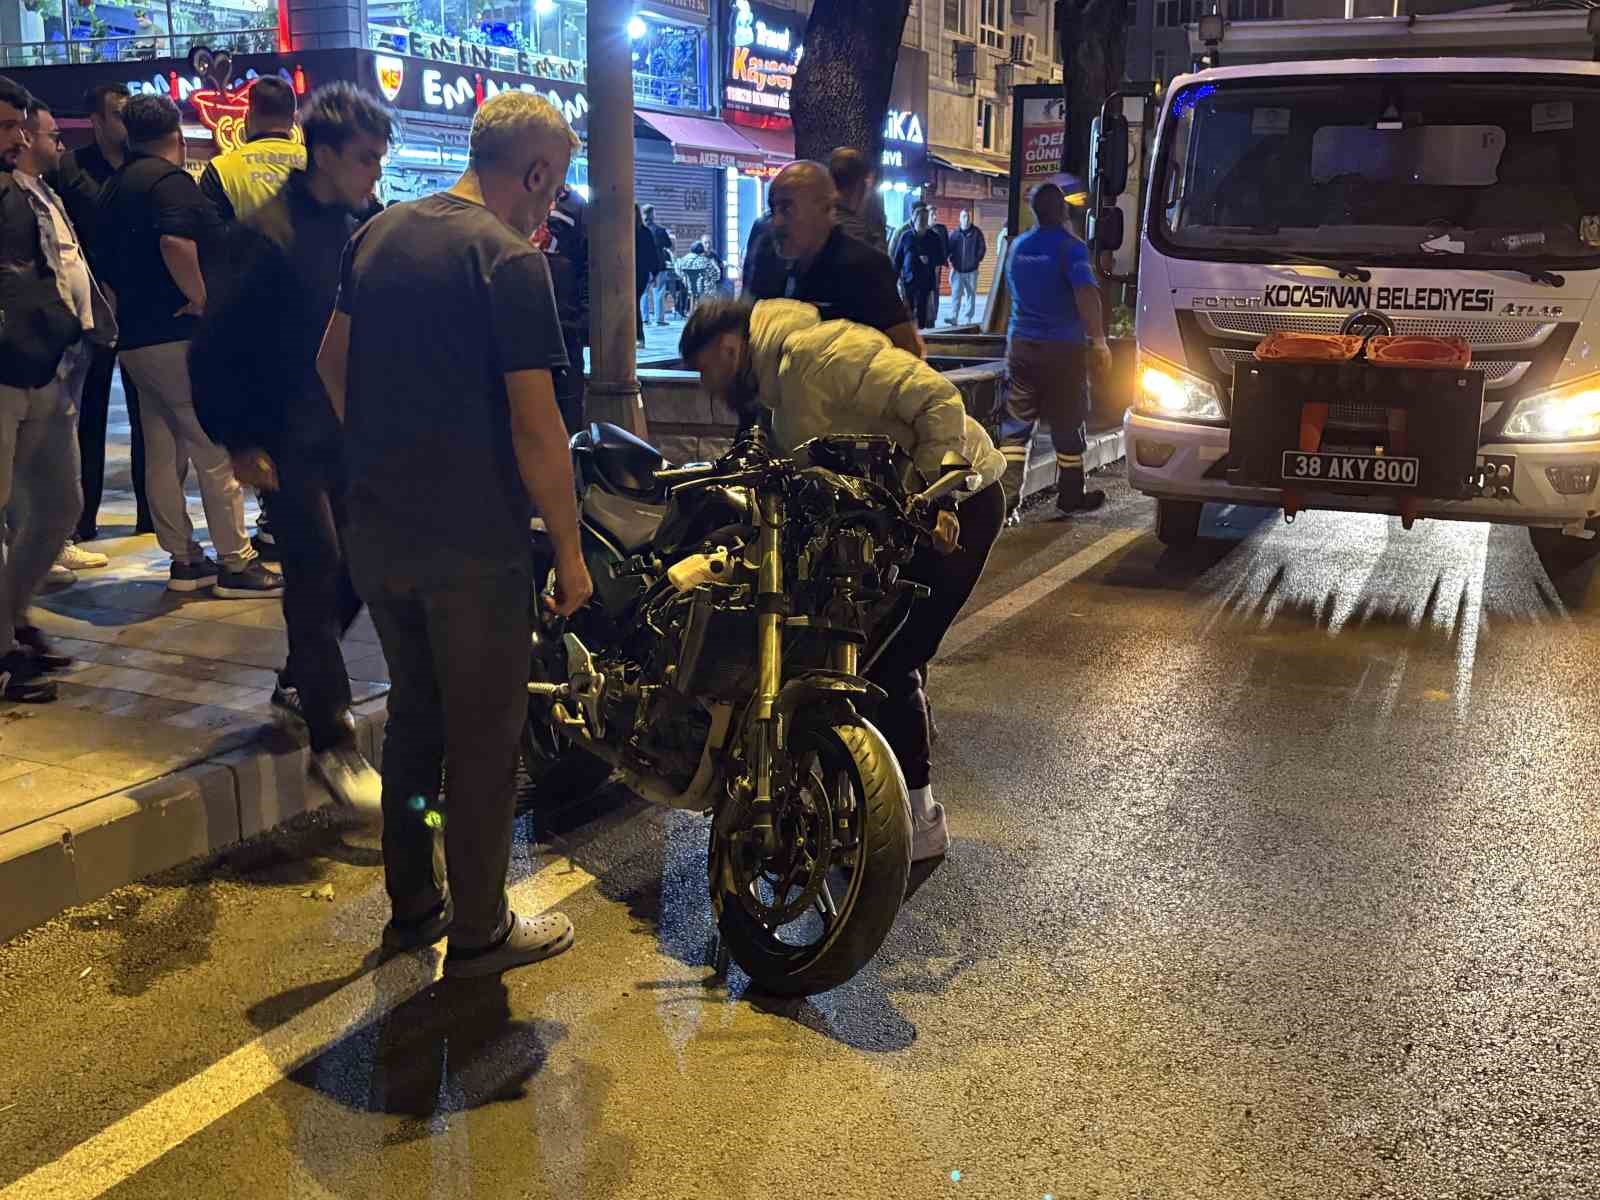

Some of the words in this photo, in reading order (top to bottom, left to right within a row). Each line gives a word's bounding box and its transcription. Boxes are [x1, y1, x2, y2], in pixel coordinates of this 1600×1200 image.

[1295, 456, 1321, 477] 38
[1328, 457, 1369, 480] AKY
[1374, 460, 1414, 482] 800
